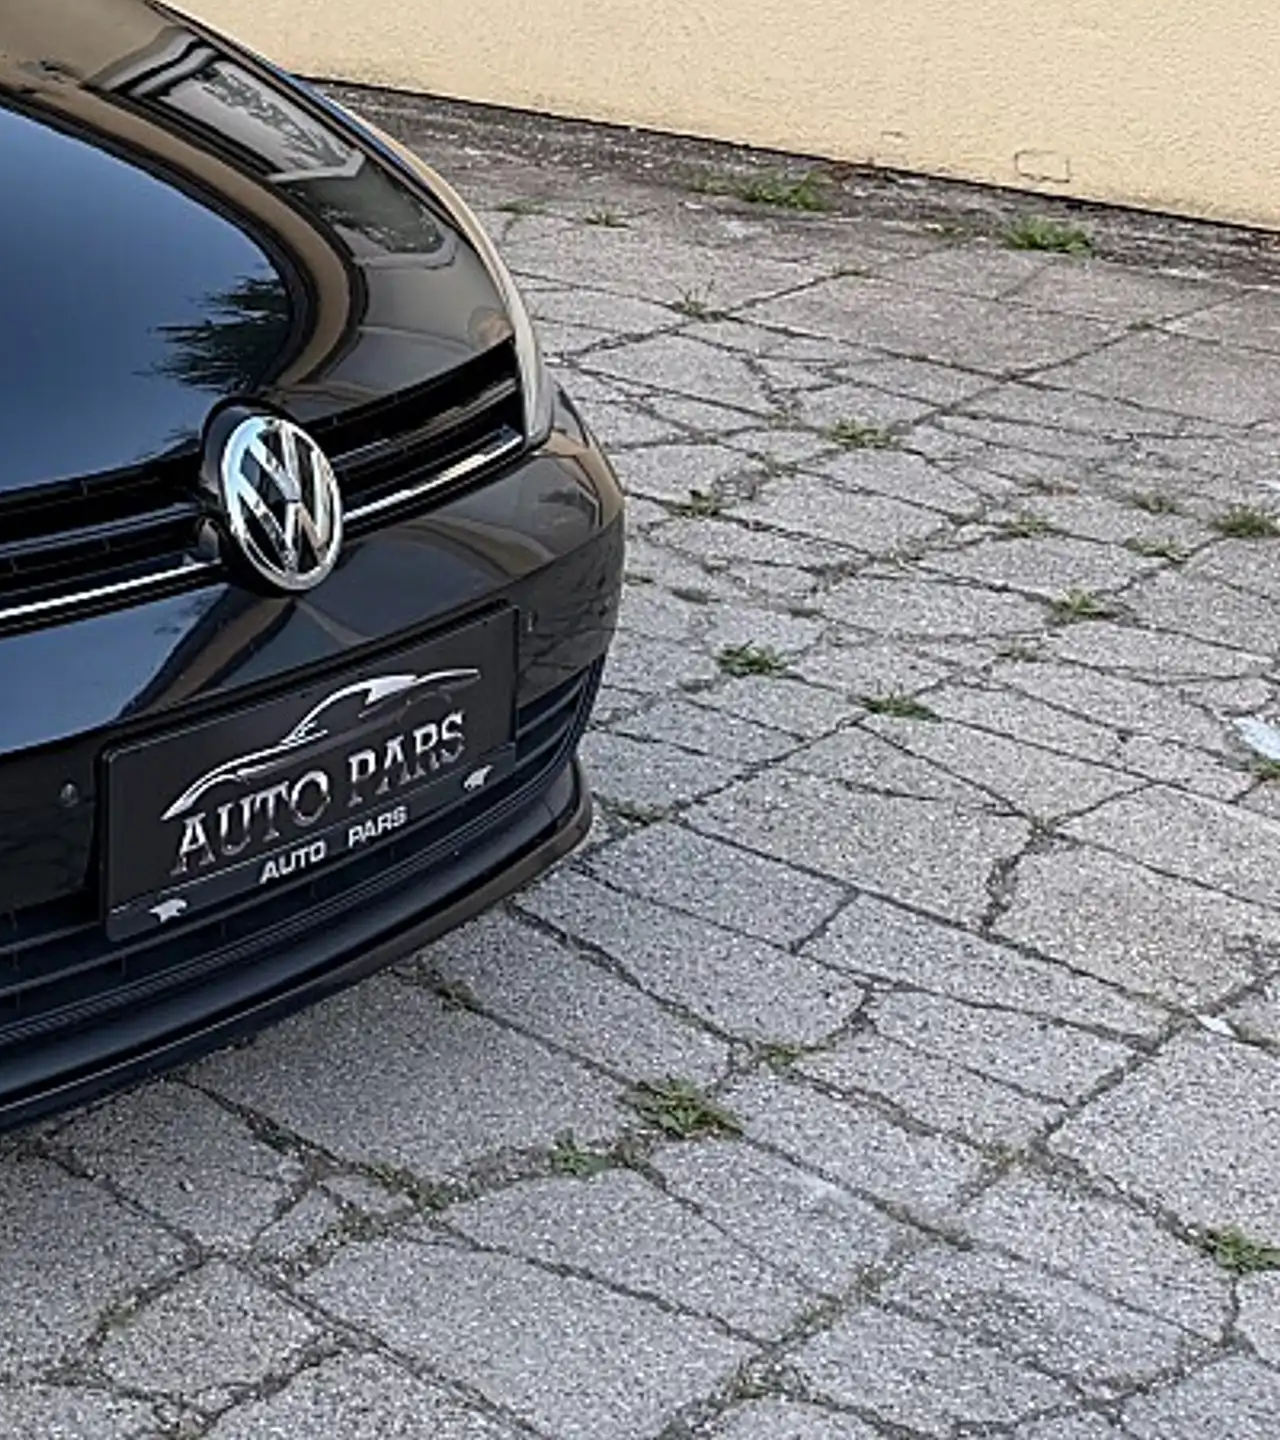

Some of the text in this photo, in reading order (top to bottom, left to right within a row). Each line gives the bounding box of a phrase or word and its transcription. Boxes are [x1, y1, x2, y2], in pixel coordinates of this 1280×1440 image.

[170, 710, 466, 876] AUTO PARS
[259, 806, 408, 885] AUTO PARS
